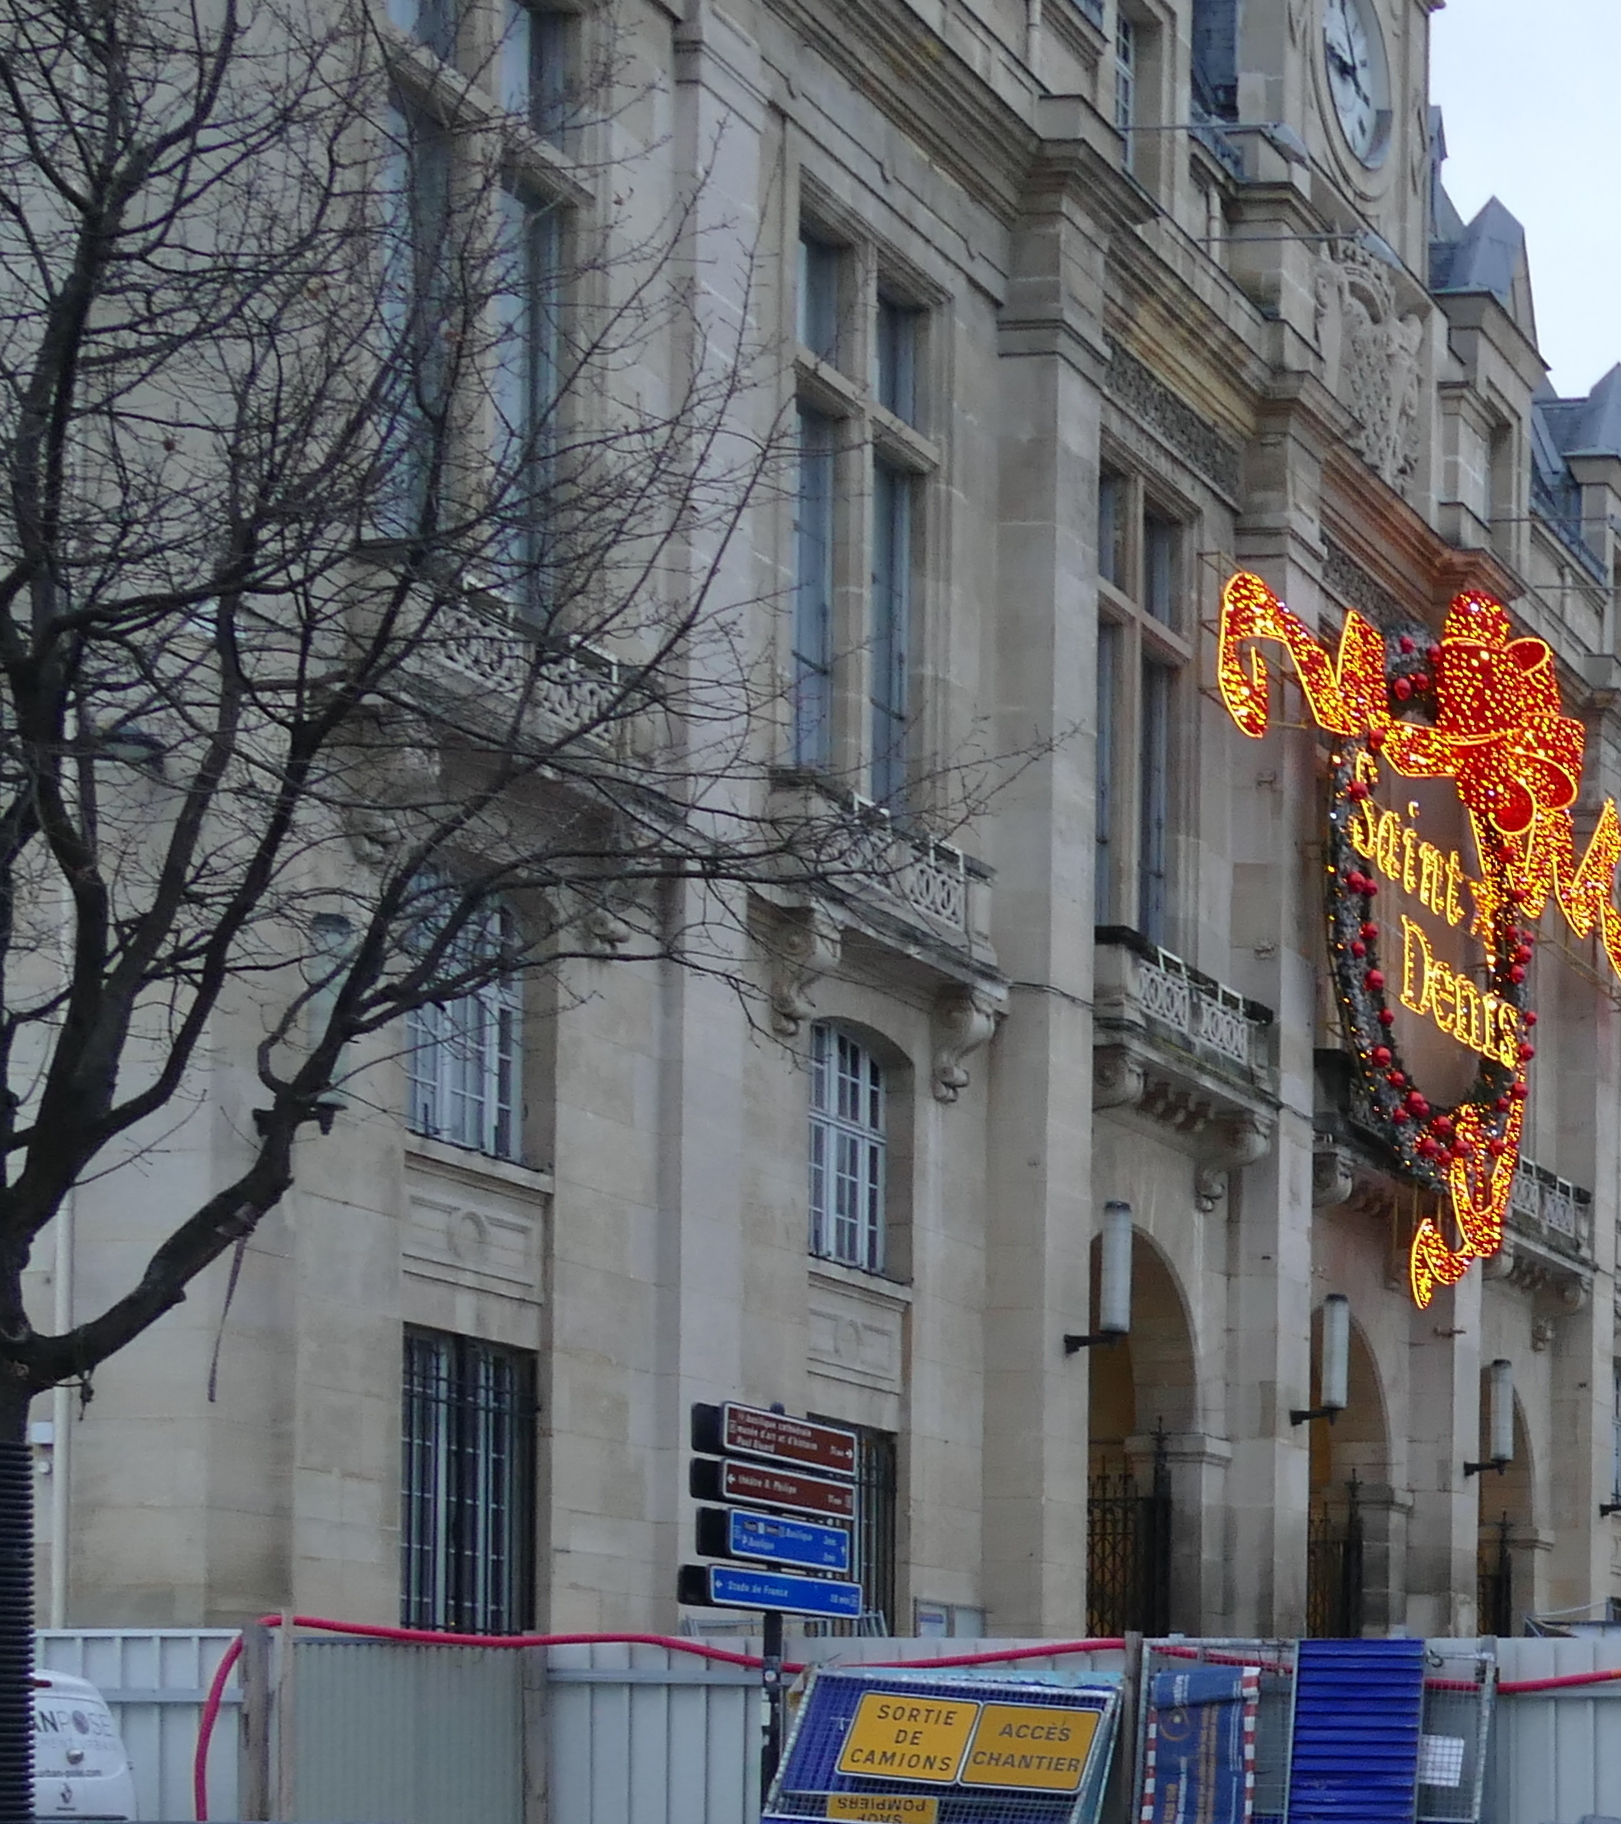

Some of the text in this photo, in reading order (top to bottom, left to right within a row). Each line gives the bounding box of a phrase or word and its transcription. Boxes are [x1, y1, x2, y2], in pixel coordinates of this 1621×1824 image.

[1352, 750, 1466, 927] Saint
[1400, 914, 1519, 1071] Denis
[877, 1704, 958, 1726] SORTIE
[895, 1729, 923, 1746] DE
[998, 1722, 1072, 1742] ACCÈS
[850, 1748, 952, 1772] CAMIONS
[972, 1750, 1081, 1773] CHANTIER
[838, 1798, 926, 1812] POMPIERS
